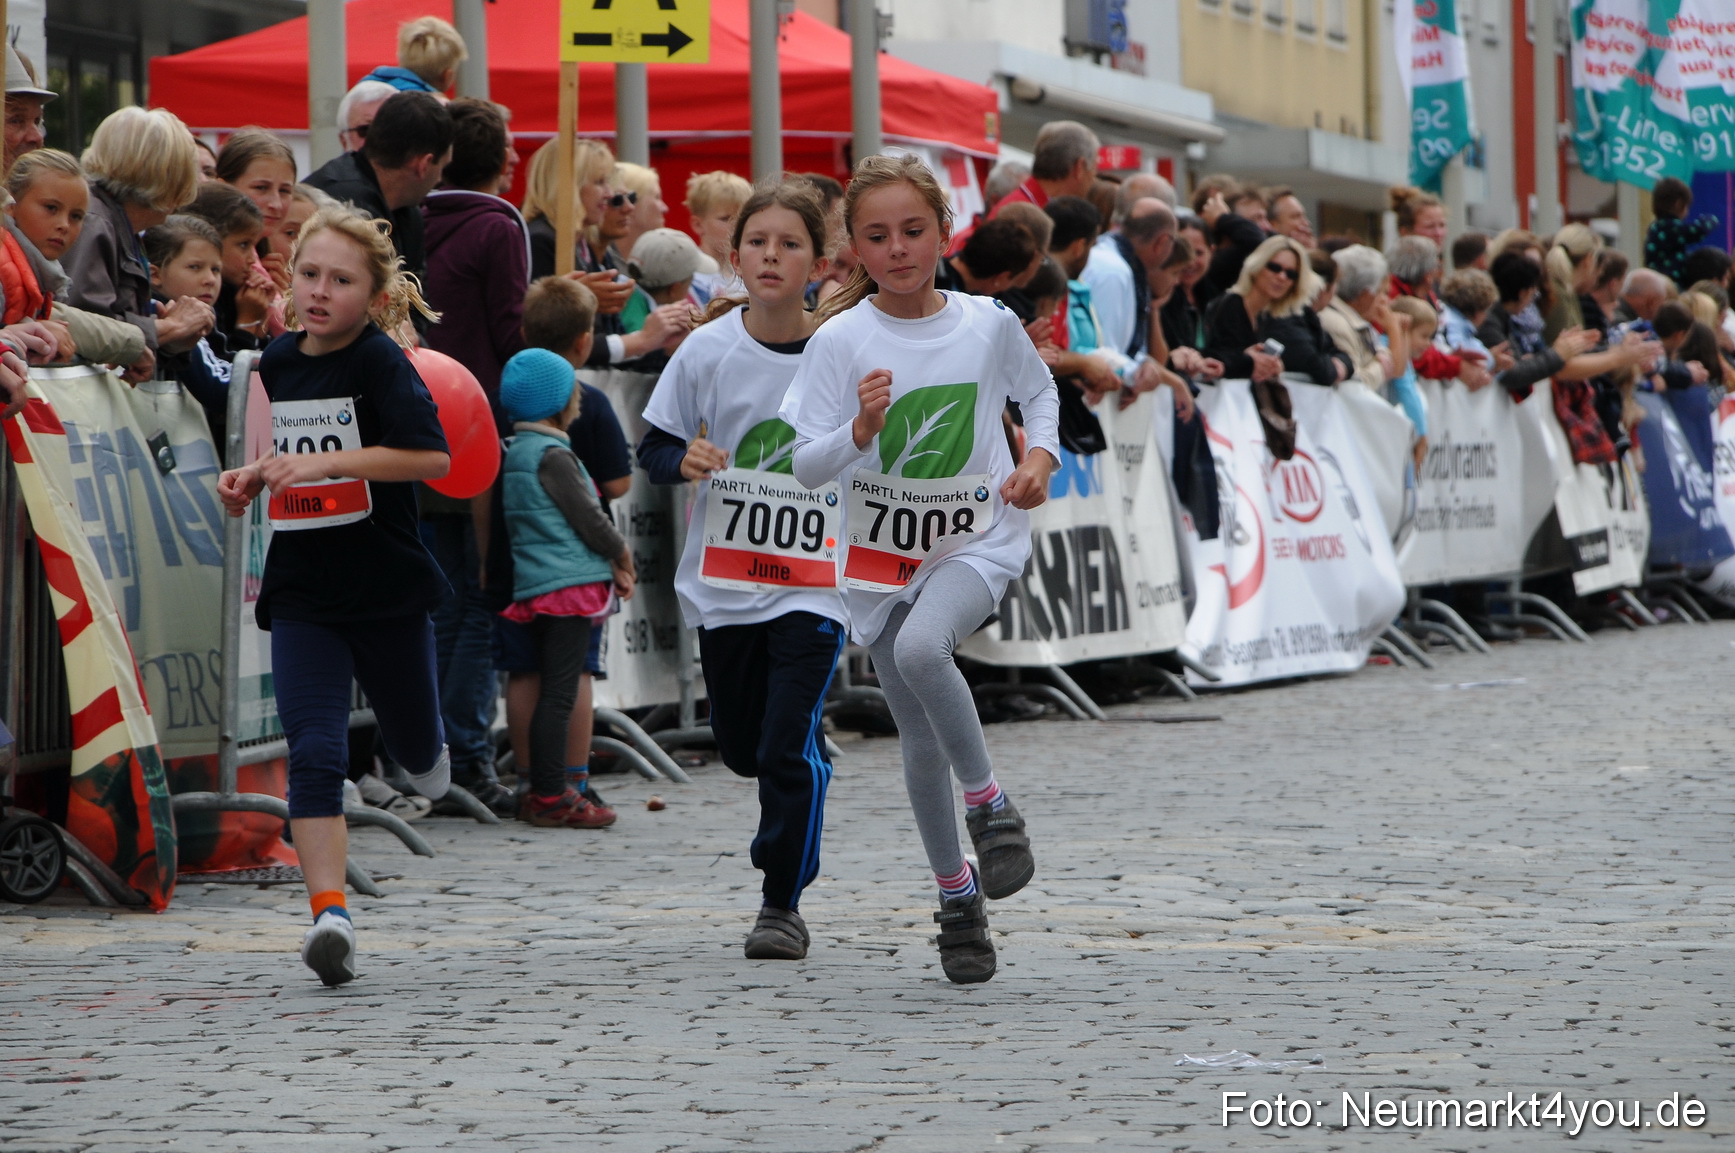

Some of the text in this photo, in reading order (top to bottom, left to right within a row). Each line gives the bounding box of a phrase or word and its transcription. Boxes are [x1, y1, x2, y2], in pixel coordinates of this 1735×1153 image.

[281, 414, 332, 428] Neumarkt
[711, 478, 821, 503] PARTL Neumarkt
[852, 480, 968, 503] PARTL Neumarkt
[1281, 463, 1319, 505] KIA
[284, 494, 323, 514] Alina
[722, 498, 825, 553] 7009
[865, 500, 974, 552] 7008
[747, 558, 791, 580] June
[897, 562, 917, 583] M
